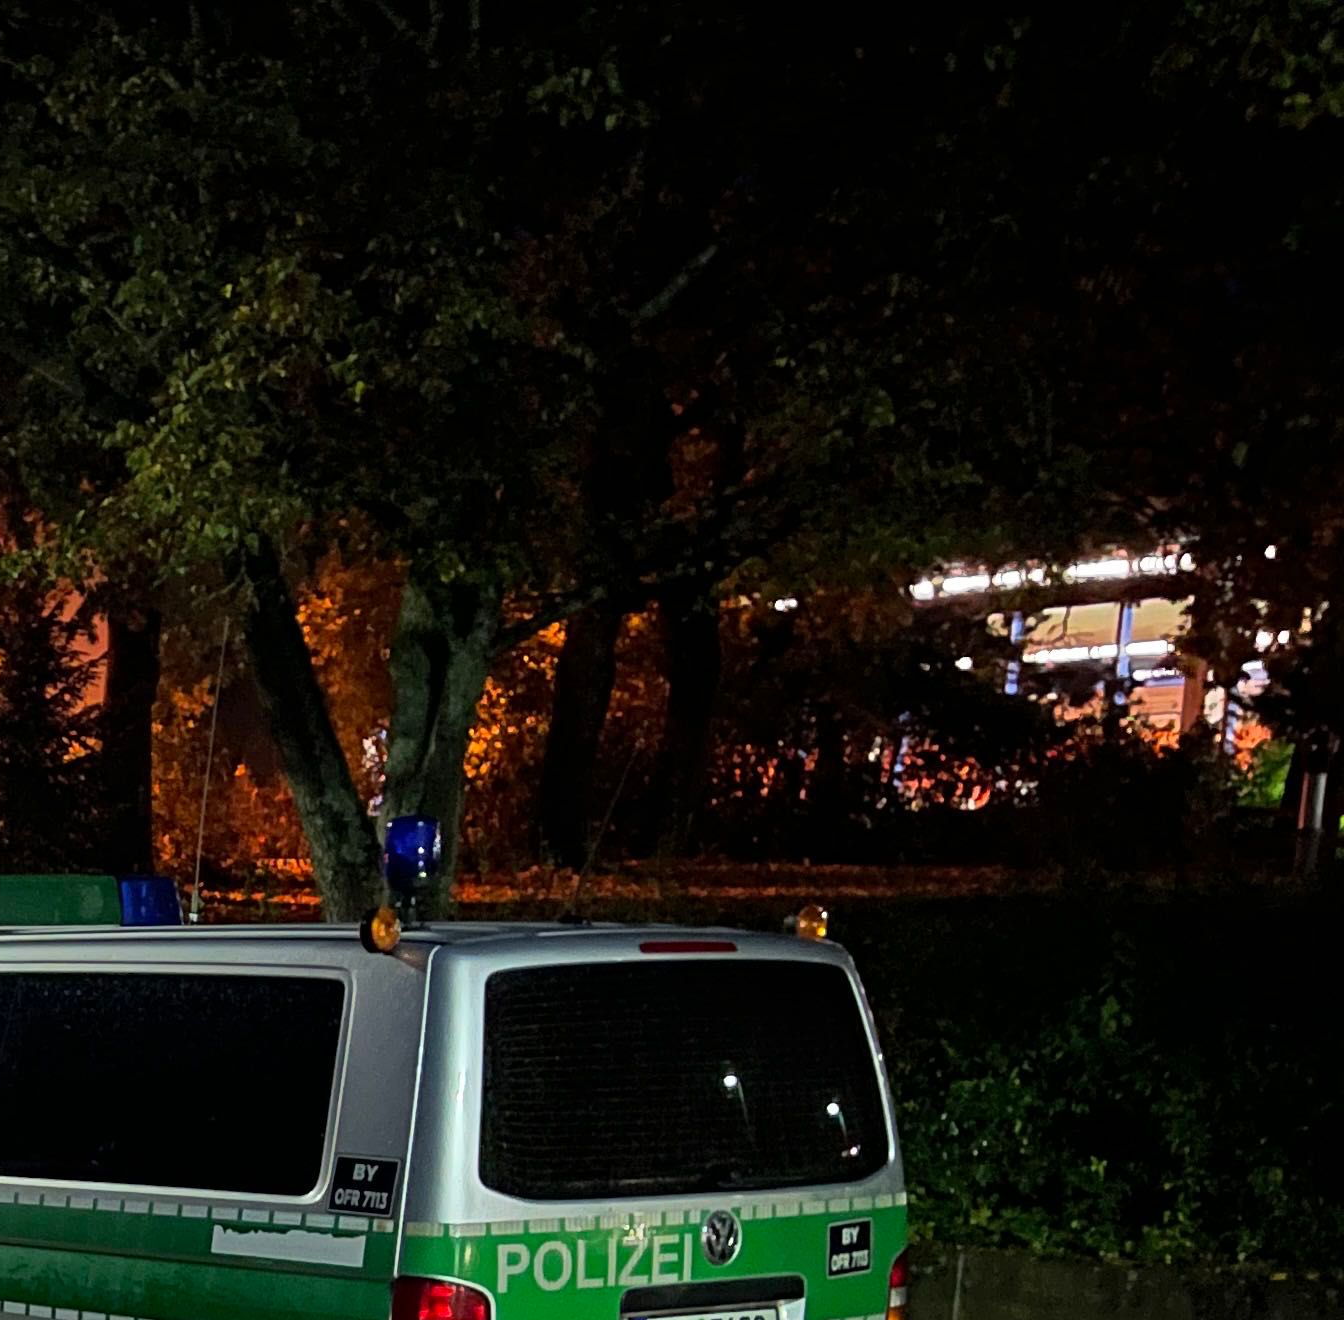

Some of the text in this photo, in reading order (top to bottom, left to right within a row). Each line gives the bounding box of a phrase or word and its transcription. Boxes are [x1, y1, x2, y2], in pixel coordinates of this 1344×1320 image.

[352, 1163, 379, 1182] BY
[334, 1188, 389, 1210] OFR 7113
[841, 1225, 860, 1246] BY
[496, 1232, 694, 1294] POLIZEI
